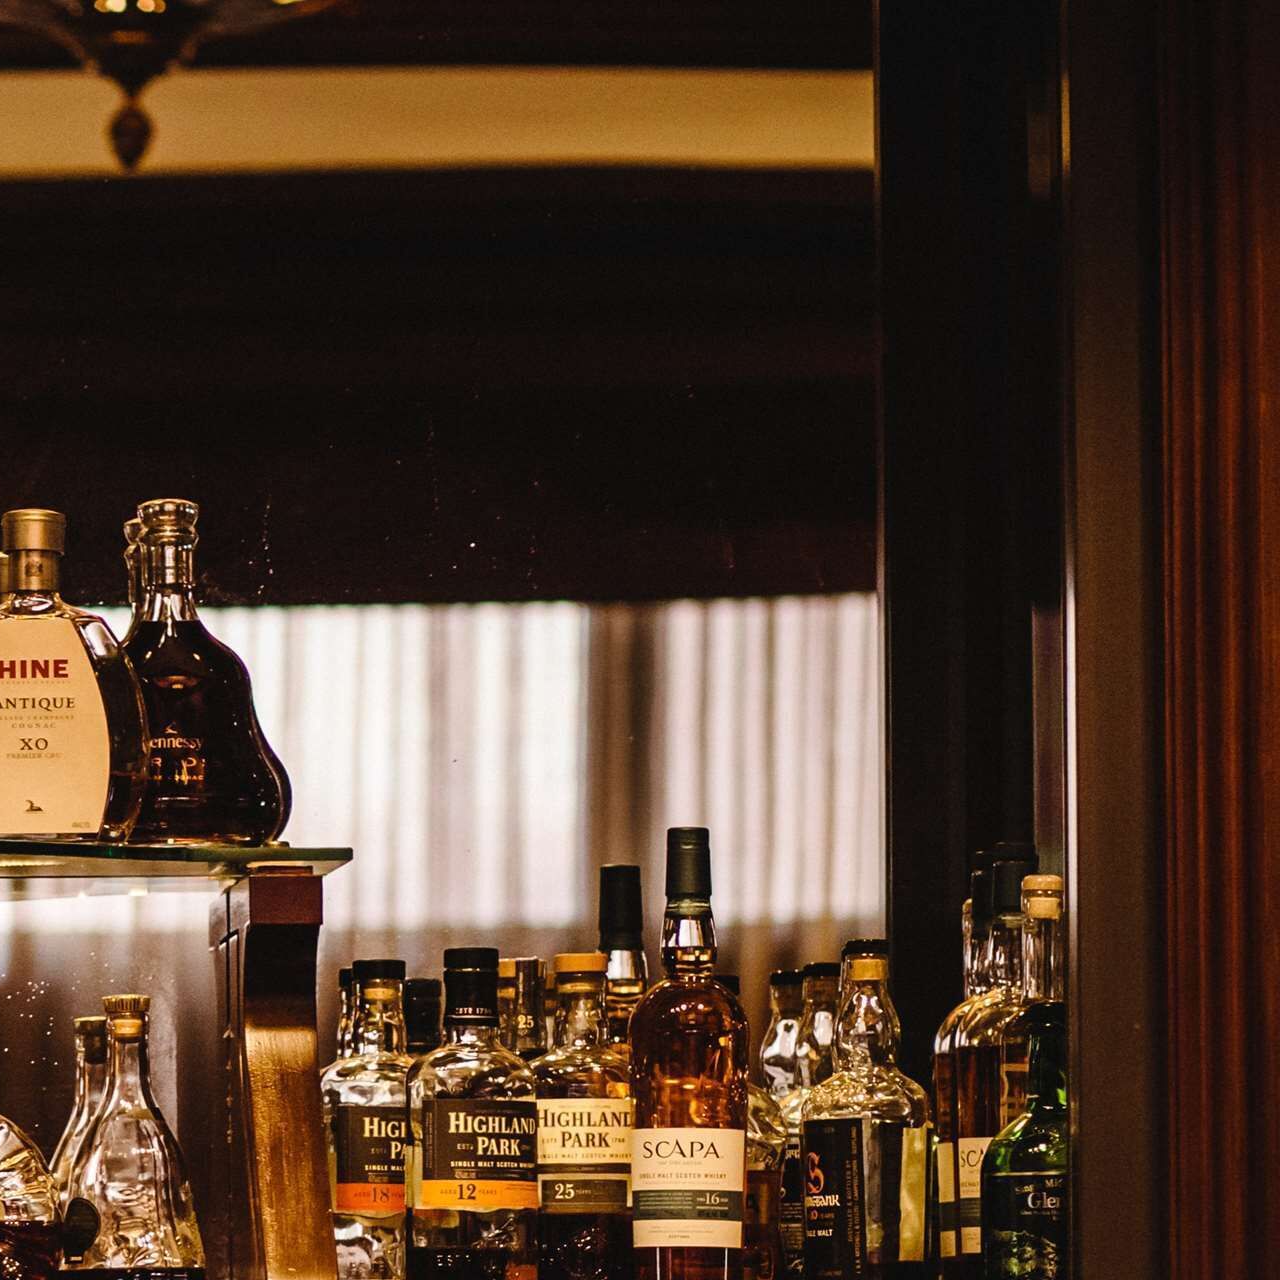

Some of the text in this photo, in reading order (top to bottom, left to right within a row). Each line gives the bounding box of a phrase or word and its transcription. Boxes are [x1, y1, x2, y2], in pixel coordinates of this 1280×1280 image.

[20, 737, 49, 751] XO
[517, 1014, 535, 1030] 25
[448, 1111, 537, 1135] HIGHLAND
[537, 1109, 633, 1128] HIGHLAND
[477, 1136, 522, 1156] PARK
[561, 1131, 611, 1149] PARK
[643, 1139, 721, 1160] SCAPA
[450, 1160, 476, 1168] SINGLE
[477, 1160, 495, 1168] MALT
[371, 1187, 390, 1204] 18
[458, 1183, 476, 1201] 12
[554, 1183, 576, 1200] 25
[704, 1191, 720, 1206] 16
